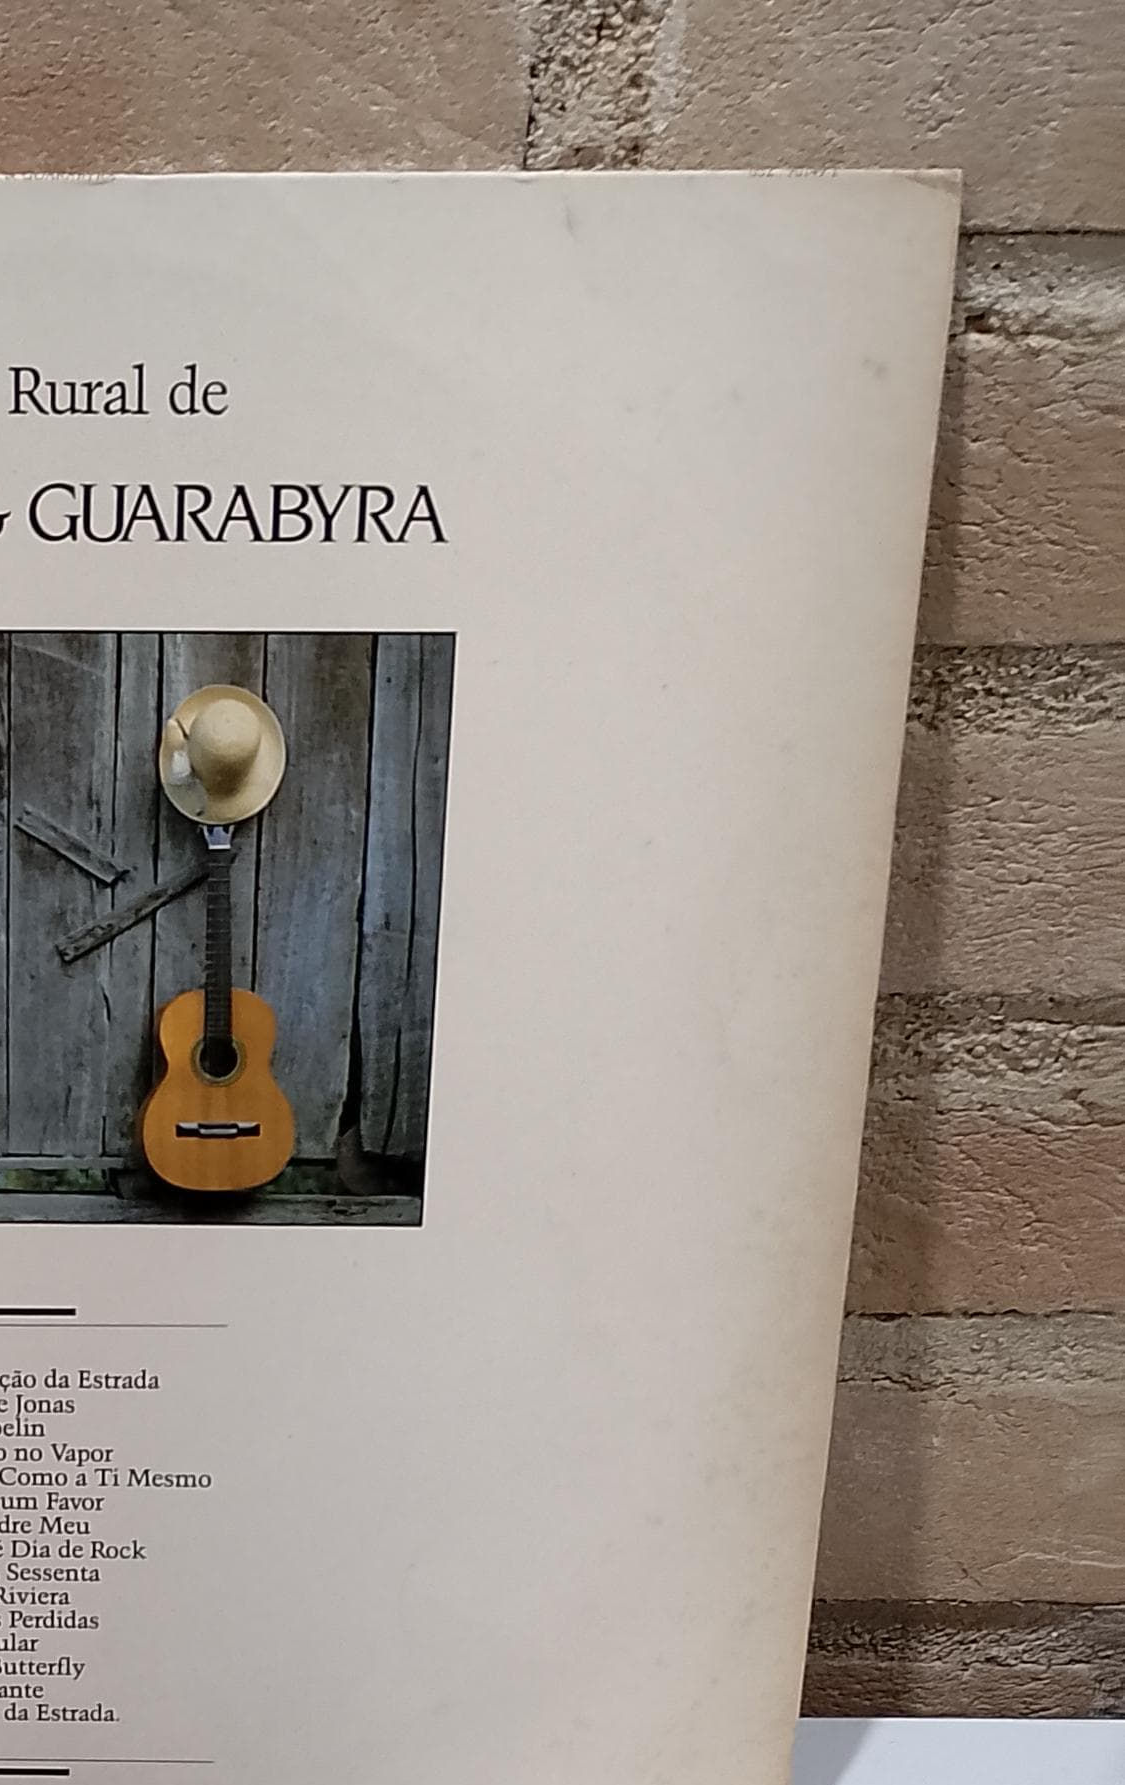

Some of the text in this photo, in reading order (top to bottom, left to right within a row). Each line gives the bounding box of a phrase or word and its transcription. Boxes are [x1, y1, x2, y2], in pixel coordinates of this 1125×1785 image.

[8, 363, 149, 415] Rural
[169, 364, 228, 415] de
[29, 483, 448, 543] GUARABYRA
[44, 1369, 70, 1388] da
[78, 1369, 159, 1389] Estrada
[16, 1394, 75, 1416] Jonas
[14, 1448, 42, 1461] no
[51, 1443, 113, 1465] Vapor
[0, 1467, 67, 1486] Como
[75, 1473, 87, 1486] a
[94, 1468, 119, 1486] Ti
[127, 1469, 211, 1488] Mesmo
[1, 1496, 38, 1510] um
[47, 1492, 105, 1511] Favor
[39, 1516, 90, 1534] Meu
[11, 1540, 51, 1558] Dia
[59, 1539, 83, 1558] de
[91, 1540, 146, 1559] Rock
[7, 1563, 100, 1582] Sessenta
[9, 1610, 99, 1629] Perdidas
[4, 1702, 28, 1721] da
[36, 1703, 119, 1721] Estrada.
